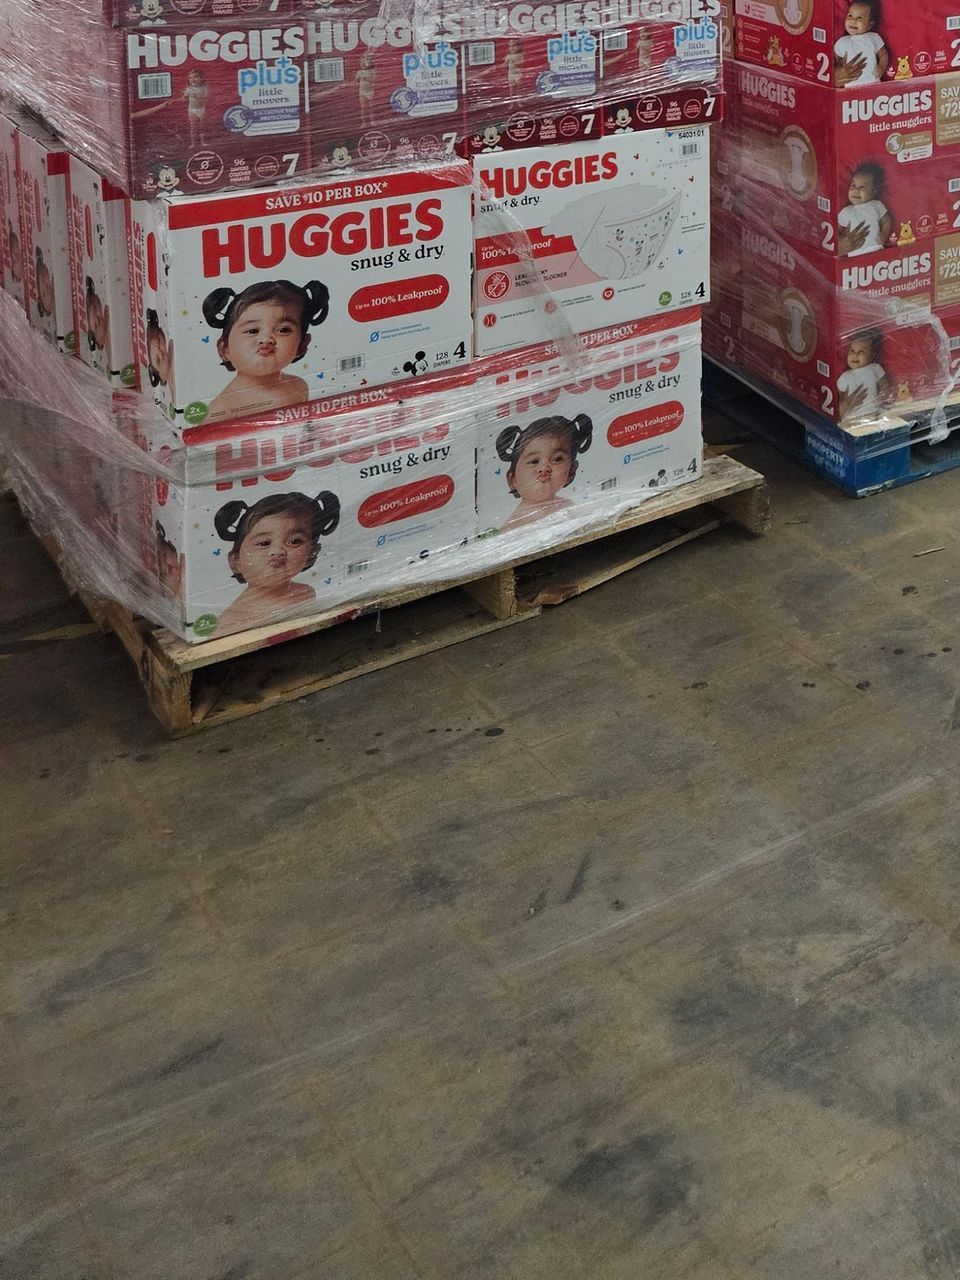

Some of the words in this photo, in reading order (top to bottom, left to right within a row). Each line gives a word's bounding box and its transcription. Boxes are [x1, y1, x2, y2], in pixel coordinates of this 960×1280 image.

[675, 16, 718, 44] plus
[127, 26, 305, 69] HUGGIES
[252, 96, 290, 106] movers
[258, 88, 283, 97] little
[842, 90, 932, 124] HUGGIES
[580, 114, 595, 135] 7
[869, 122, 891, 133] little
[891, 116, 932, 130] snugglers
[282, 153, 300, 176] 7
[480, 152, 618, 201] HUGGIES
[265, 194, 301, 211] SAVE
[303, 191, 323, 205] $10
[325, 186, 353, 202] PER
[201, 198, 444, 279] HUGGIES
[350, 250, 394, 272] snug
[397, 247, 411, 263] &
[414, 243, 445, 261] dry
[842, 252, 932, 291] HUGGIES
[371, 295, 397, 308] 100%
[397, 284, 443, 303] Leakproof
[695, 282, 705, 298] 4
[435, 351, 449, 362] 128
[453, 341, 467, 360] 4
[609, 384, 642, 404] snug
[645, 381, 655, 392] &
[658, 373, 681, 388] dry
[821, 386, 834, 416] 2
[276, 407, 309, 423] SAVE
[332, 395, 358, 411] PER
[624, 421, 644, 433] 100%
[645, 411, 680, 428] Leakproof
[380, 499, 403, 512] 100%
[404, 486, 448, 505] Leakproof
